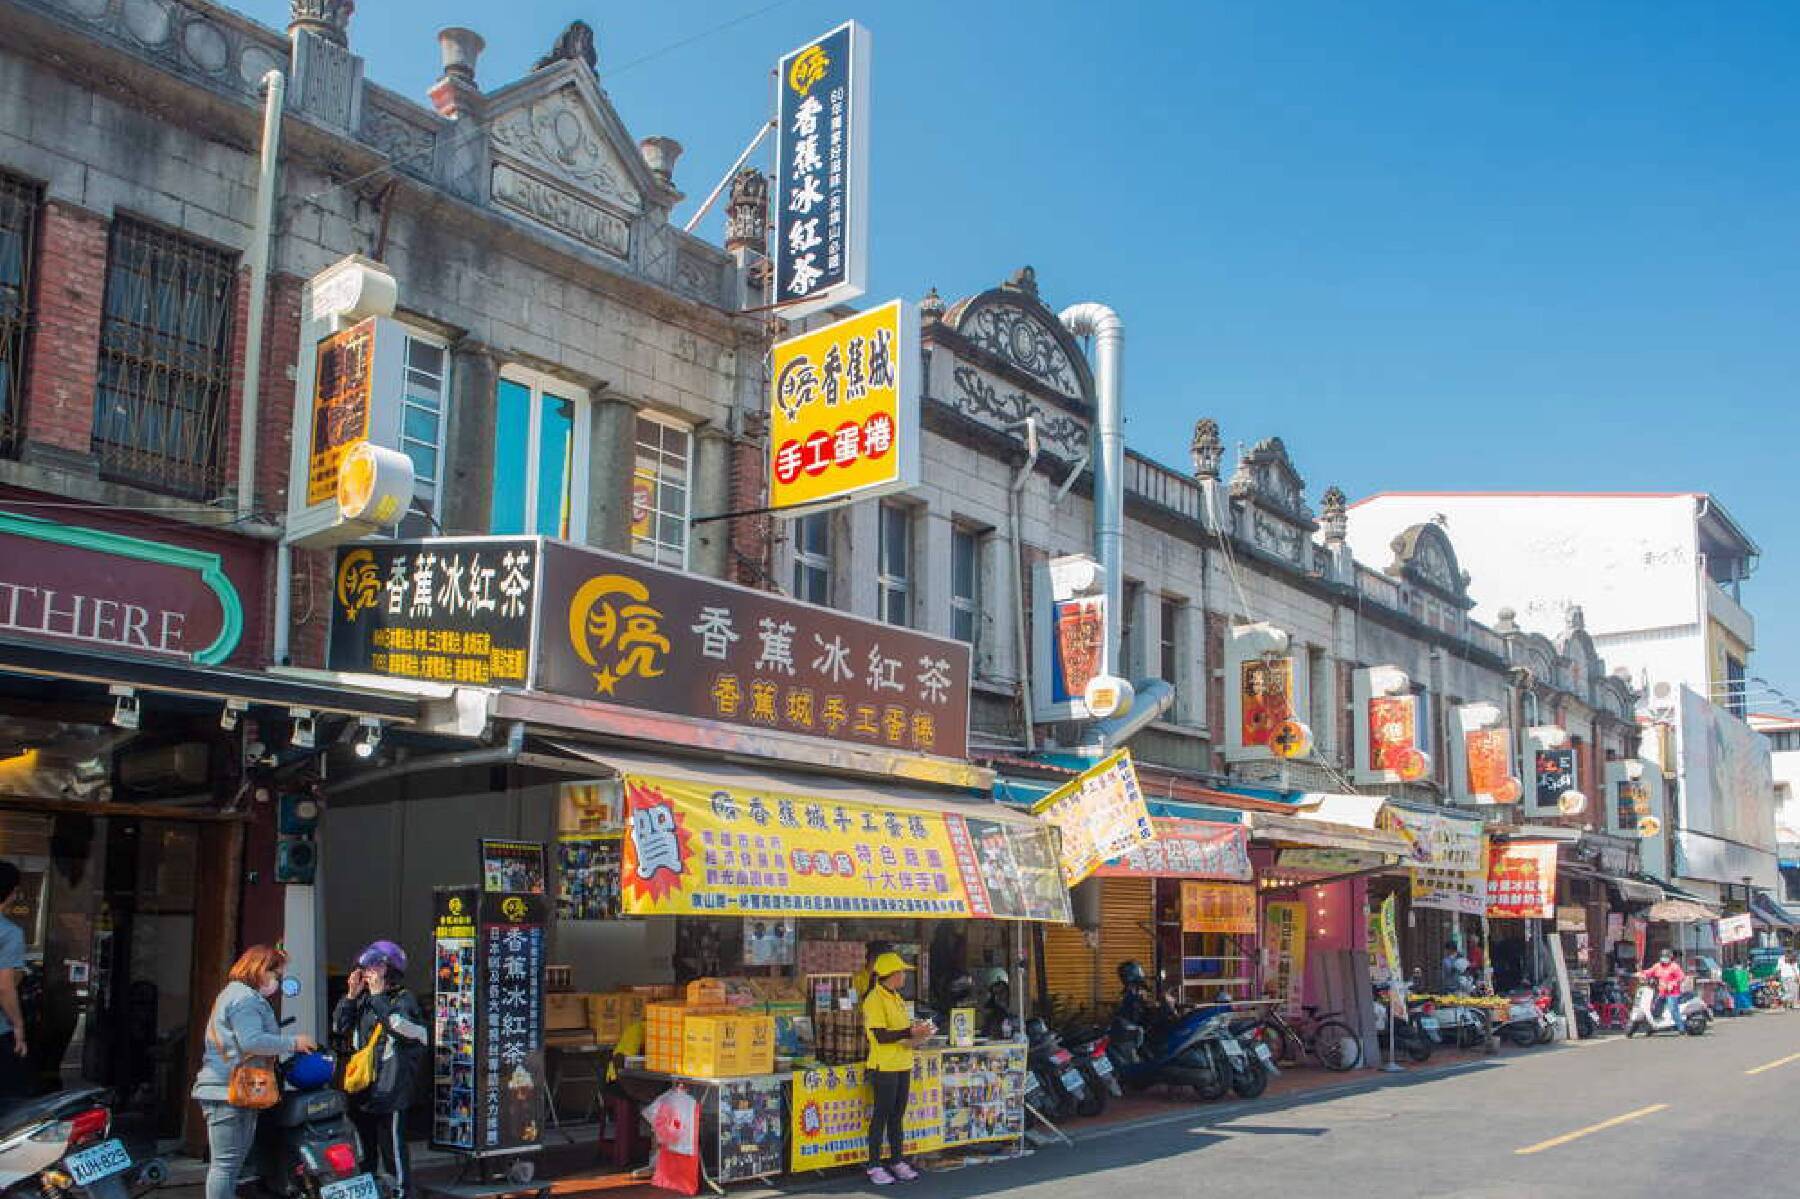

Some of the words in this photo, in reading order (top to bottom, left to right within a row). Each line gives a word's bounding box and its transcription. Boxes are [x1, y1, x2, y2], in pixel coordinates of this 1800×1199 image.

[787, 96, 824, 295] 香蕉冰紅茶
[386, 550, 530, 619] 香蕉冰紅茶
[691, 605, 953, 704] 香蕉冰紅茶
[711, 675, 937, 750] 香蕉城手工蛋捲
[502, 926, 528, 1066] 香蕉冰紅茶
